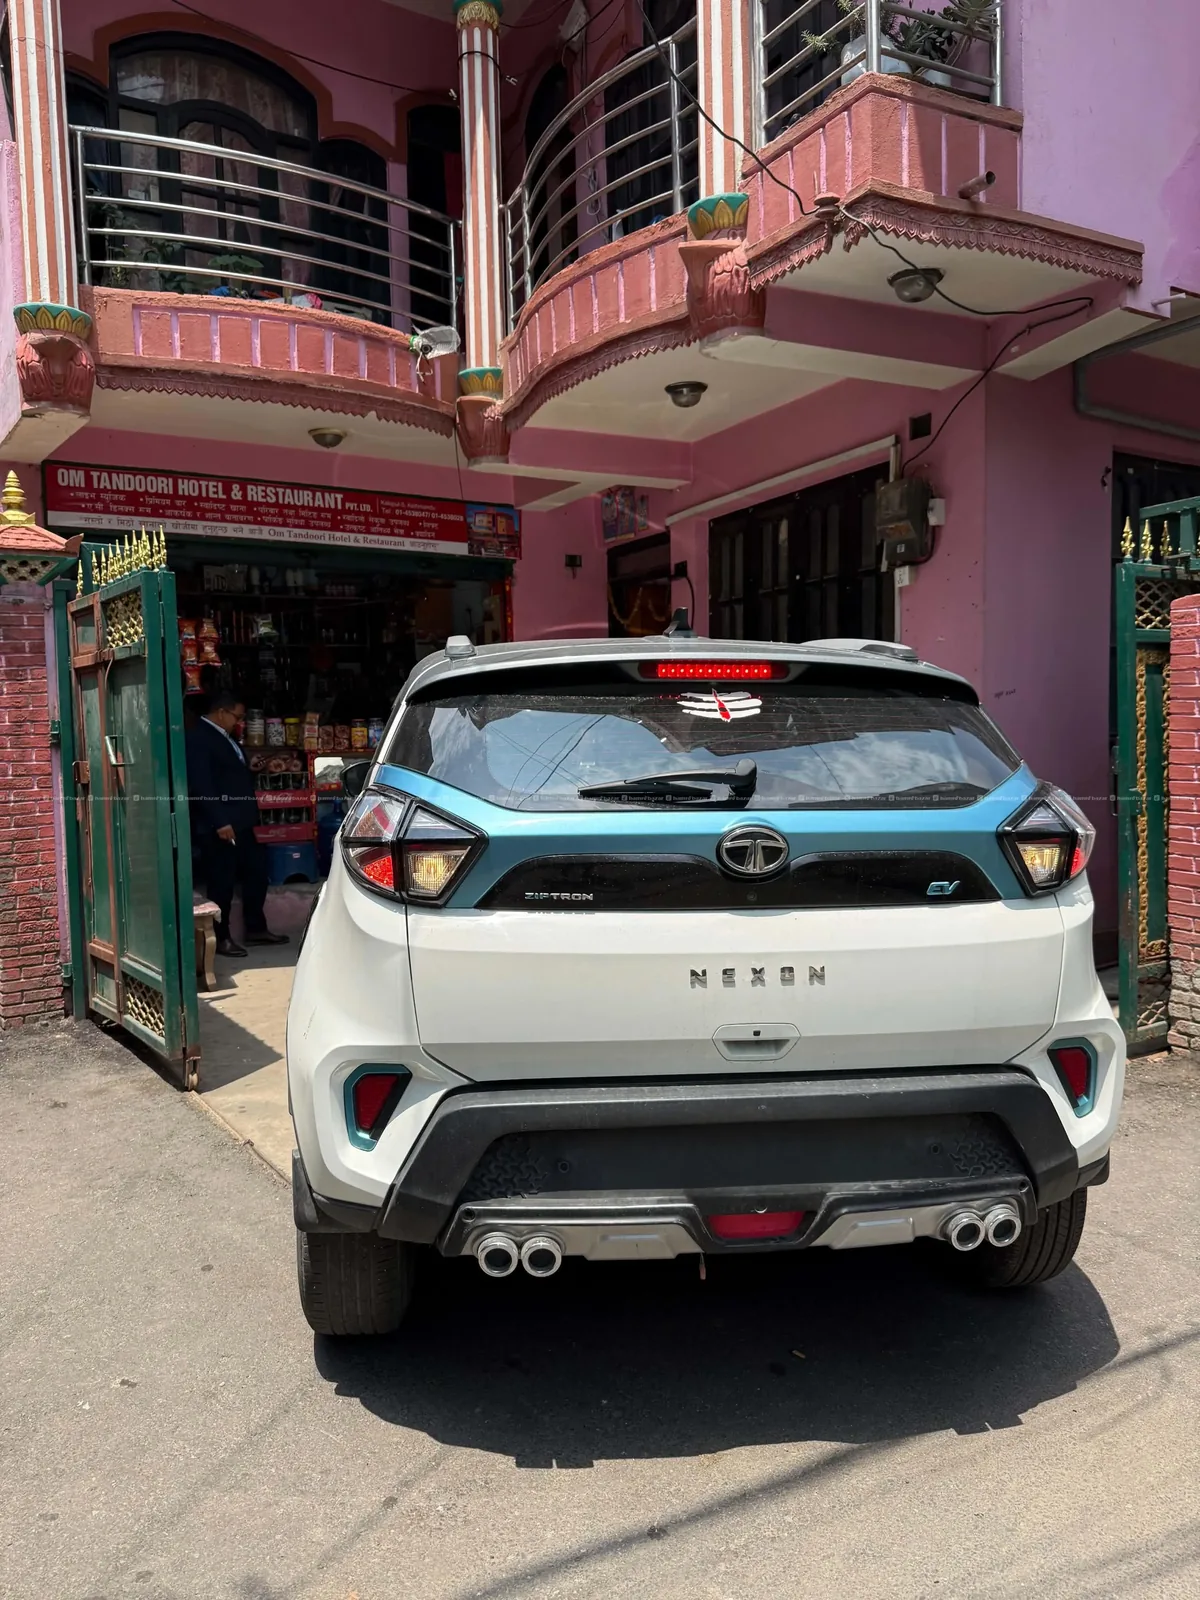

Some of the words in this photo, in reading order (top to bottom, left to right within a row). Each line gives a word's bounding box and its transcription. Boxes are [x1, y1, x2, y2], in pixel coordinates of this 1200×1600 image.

[57, 468, 85, 487] OM
[90, 471, 173, 494] TANDOORI
[178, 478, 226, 499] HOTEL
[231, 484, 242, 500] &
[247, 485, 343, 510] RESTAURANT
[346, 502, 359, 511] PVT.
[360, 504, 373, 512] LTD.
[268, 529, 284, 537] Om
[287, 530, 326, 541] Tandoori
[328, 532, 351, 543] Hotel
[353, 536, 361, 544] &
[363, 536, 405, 547] Restaurant
[524, 892, 594, 900] ZIPTRON
[926, 880, 960, 895] EV
[690, 966, 825, 986] NEXON
